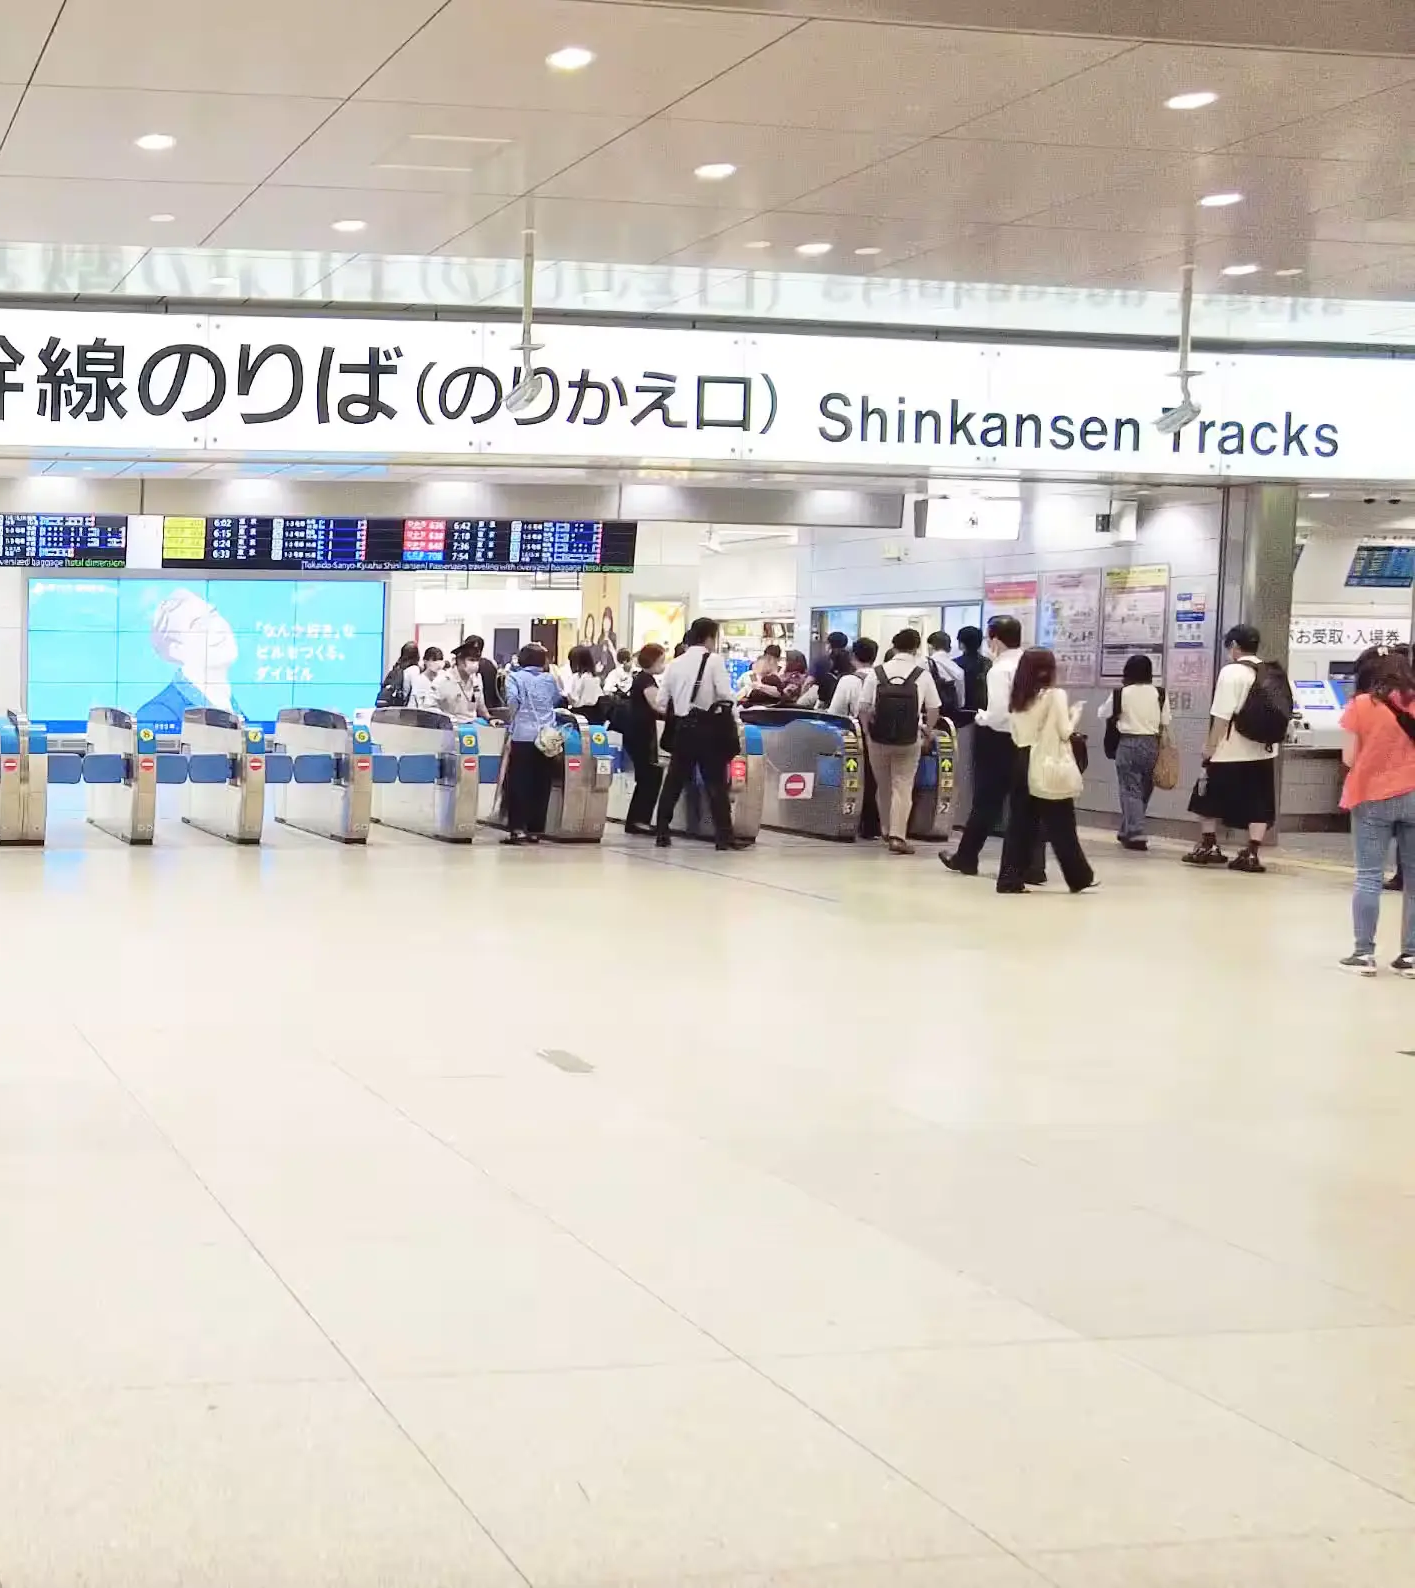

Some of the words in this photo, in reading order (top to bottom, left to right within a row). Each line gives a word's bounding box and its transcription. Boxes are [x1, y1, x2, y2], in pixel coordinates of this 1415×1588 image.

[818, 392, 1140, 452] Shinkansen
[214, 518, 232, 527] 6:02
[453, 521, 471, 530] 6:42
[213, 528, 231, 538] 6:15
[213, 539, 231, 548] 6:24
[452, 542, 470, 550] 7:36
[451, 552, 469, 561] 7:54
[1288, 628, 1400, 646] お受取・入場券
[465, 735, 474, 745] 5
[938, 802, 950, 814] 2
